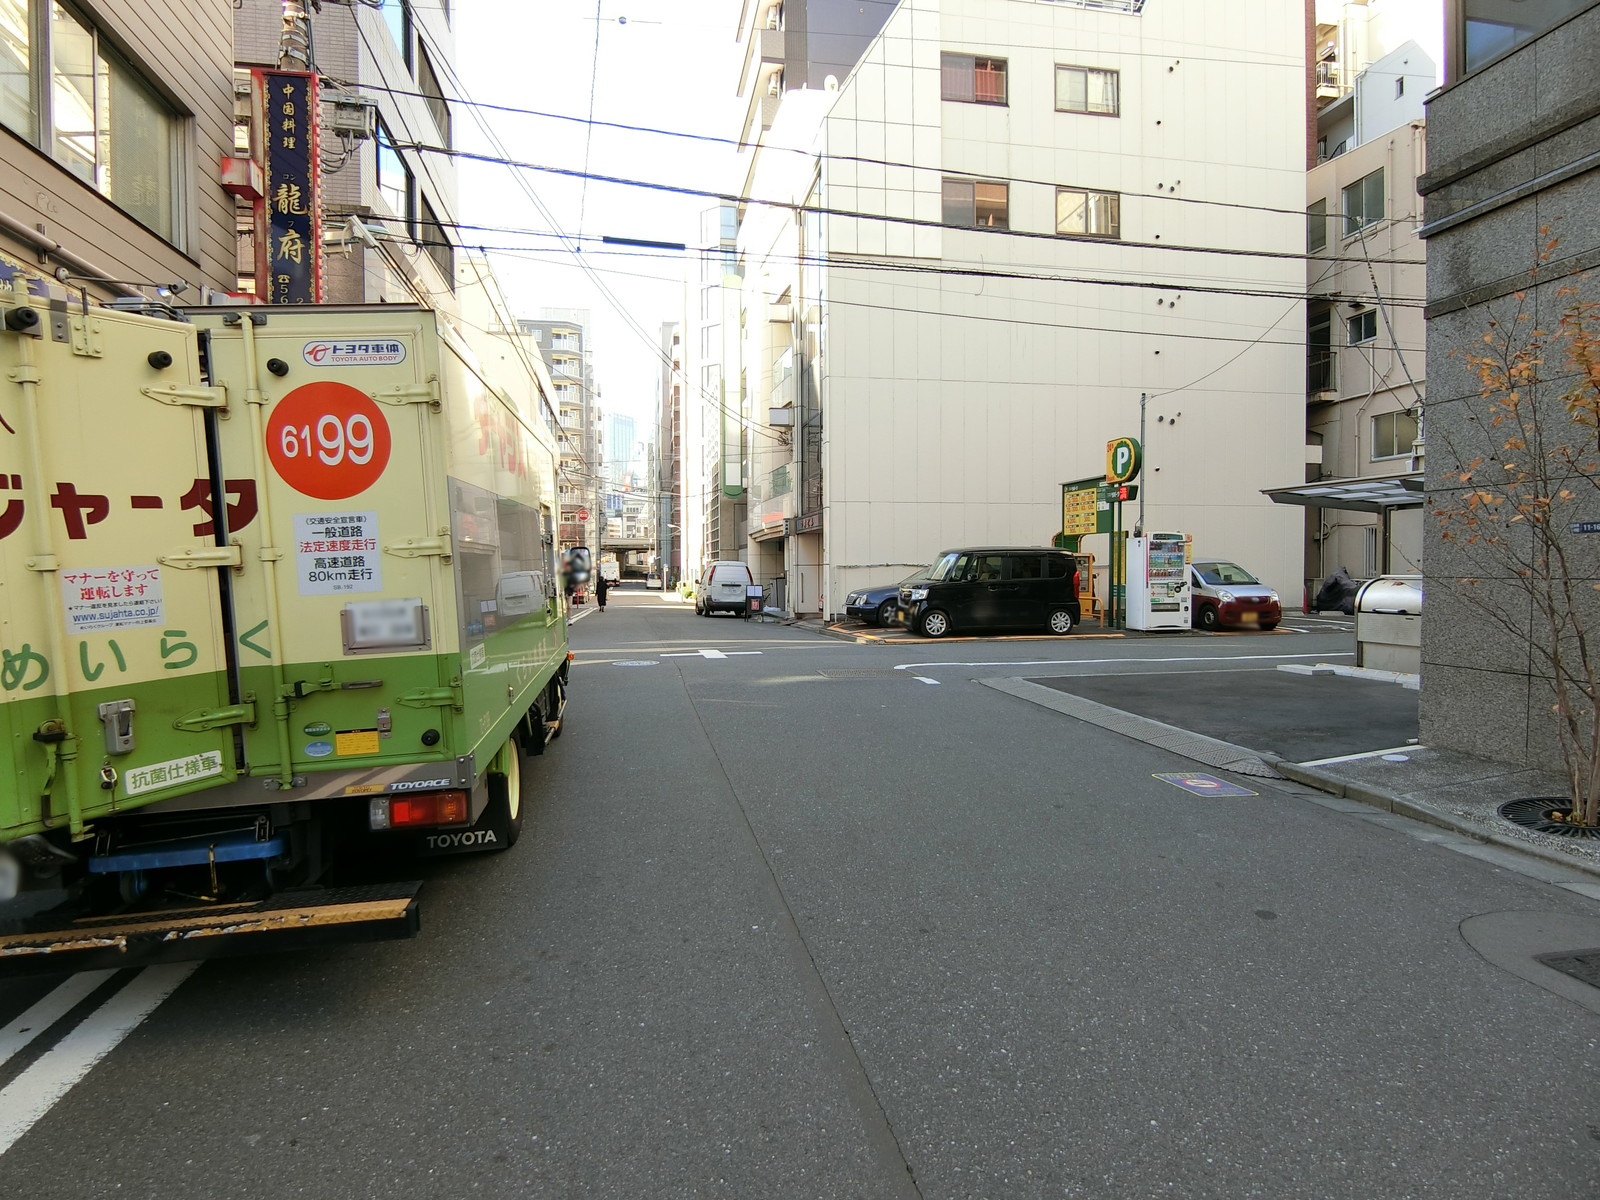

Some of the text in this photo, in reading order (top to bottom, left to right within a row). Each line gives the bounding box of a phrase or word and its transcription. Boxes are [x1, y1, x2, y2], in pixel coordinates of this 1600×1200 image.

[282, 83, 296, 149] 中国料理
[332, 344, 400, 354] トヨタ車体
[1117, 446, 1129, 474] P
[312, 525, 363, 539] 一般道路
[300, 538, 376, 553] 法定速度走行
[314, 555, 366, 569] 高速道路
[64, 568, 160, 585] マナーを守って
[308, 568, 374, 582] 80km走行
[80, 583, 149, 600] 運転します
[73, 605, 160, 622] www.sujahta.co.jp/
[131, 755, 218, 790] 抗菌仕様車
[390, 778, 451, 790] TOYOACE
[426, 829, 498, 849] TOYOTA
